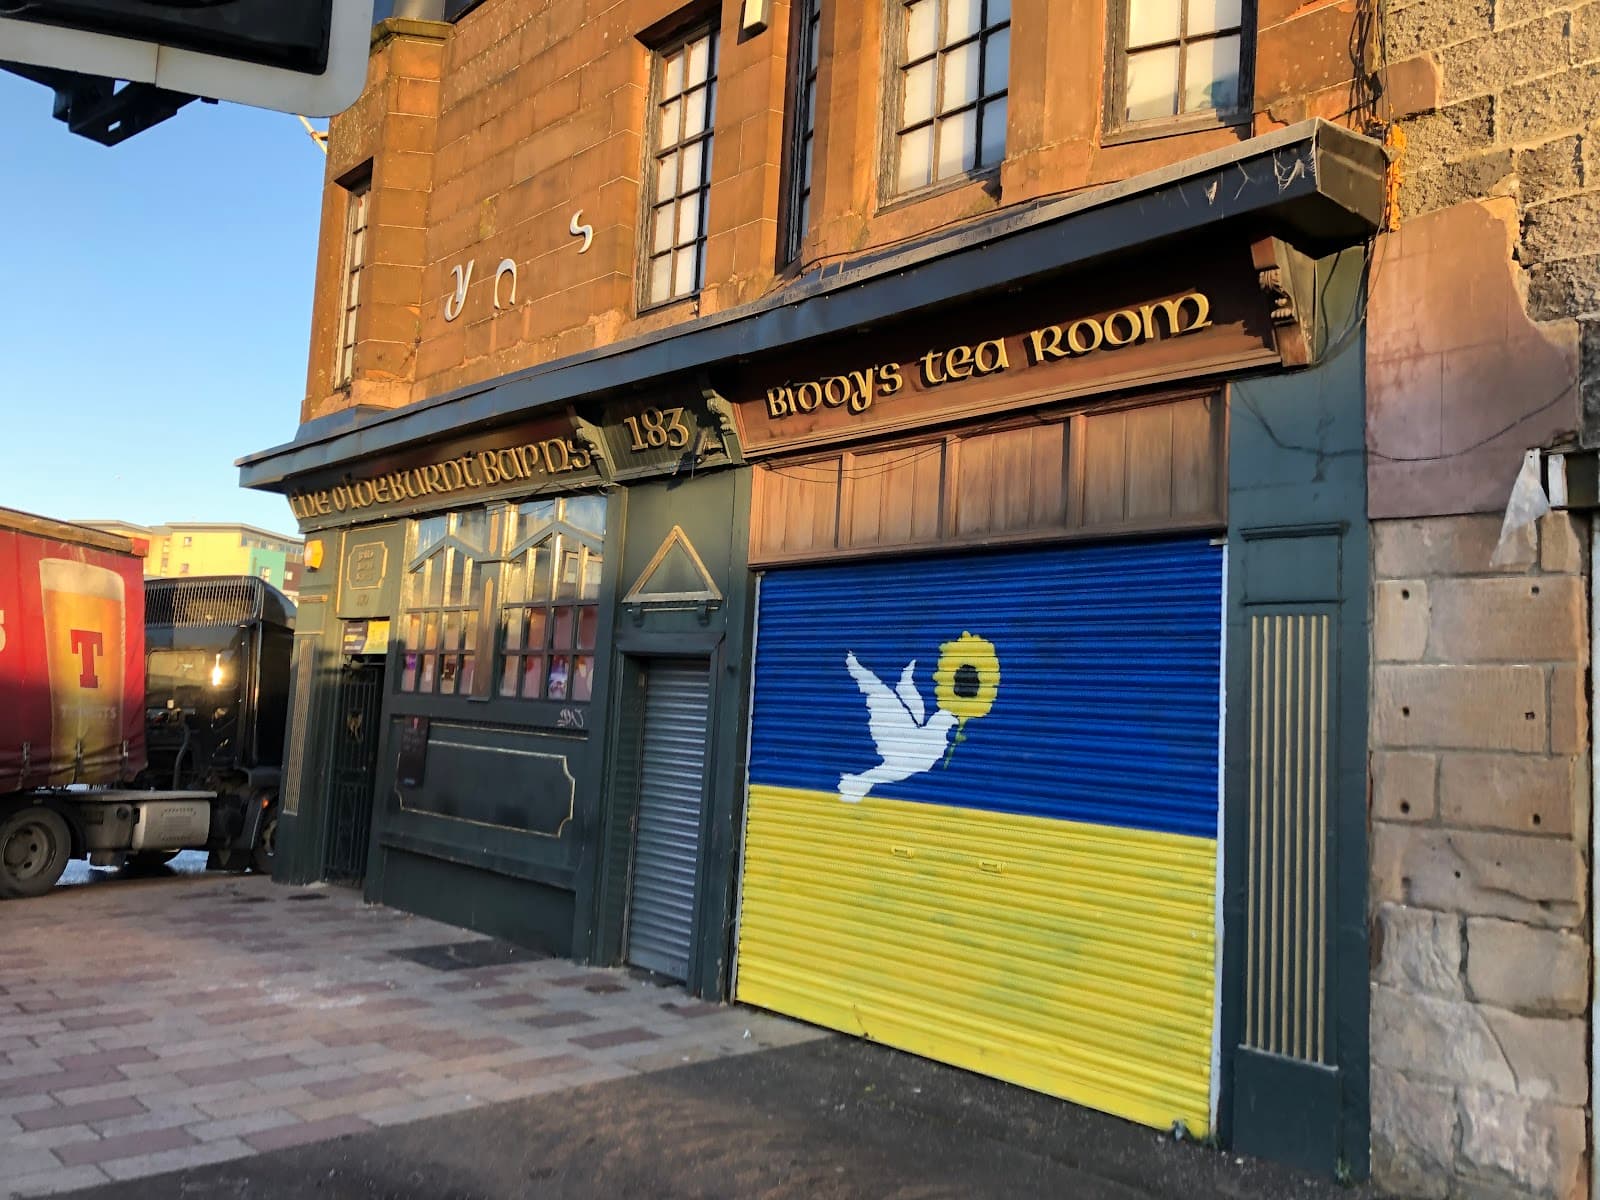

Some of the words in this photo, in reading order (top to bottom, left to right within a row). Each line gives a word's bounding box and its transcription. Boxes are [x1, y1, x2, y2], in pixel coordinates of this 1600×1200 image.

[919, 336, 1011, 385] tea
[1030, 293, 1213, 361] Room
[623, 406, 689, 451] 183
[70, 629, 103, 689] T
